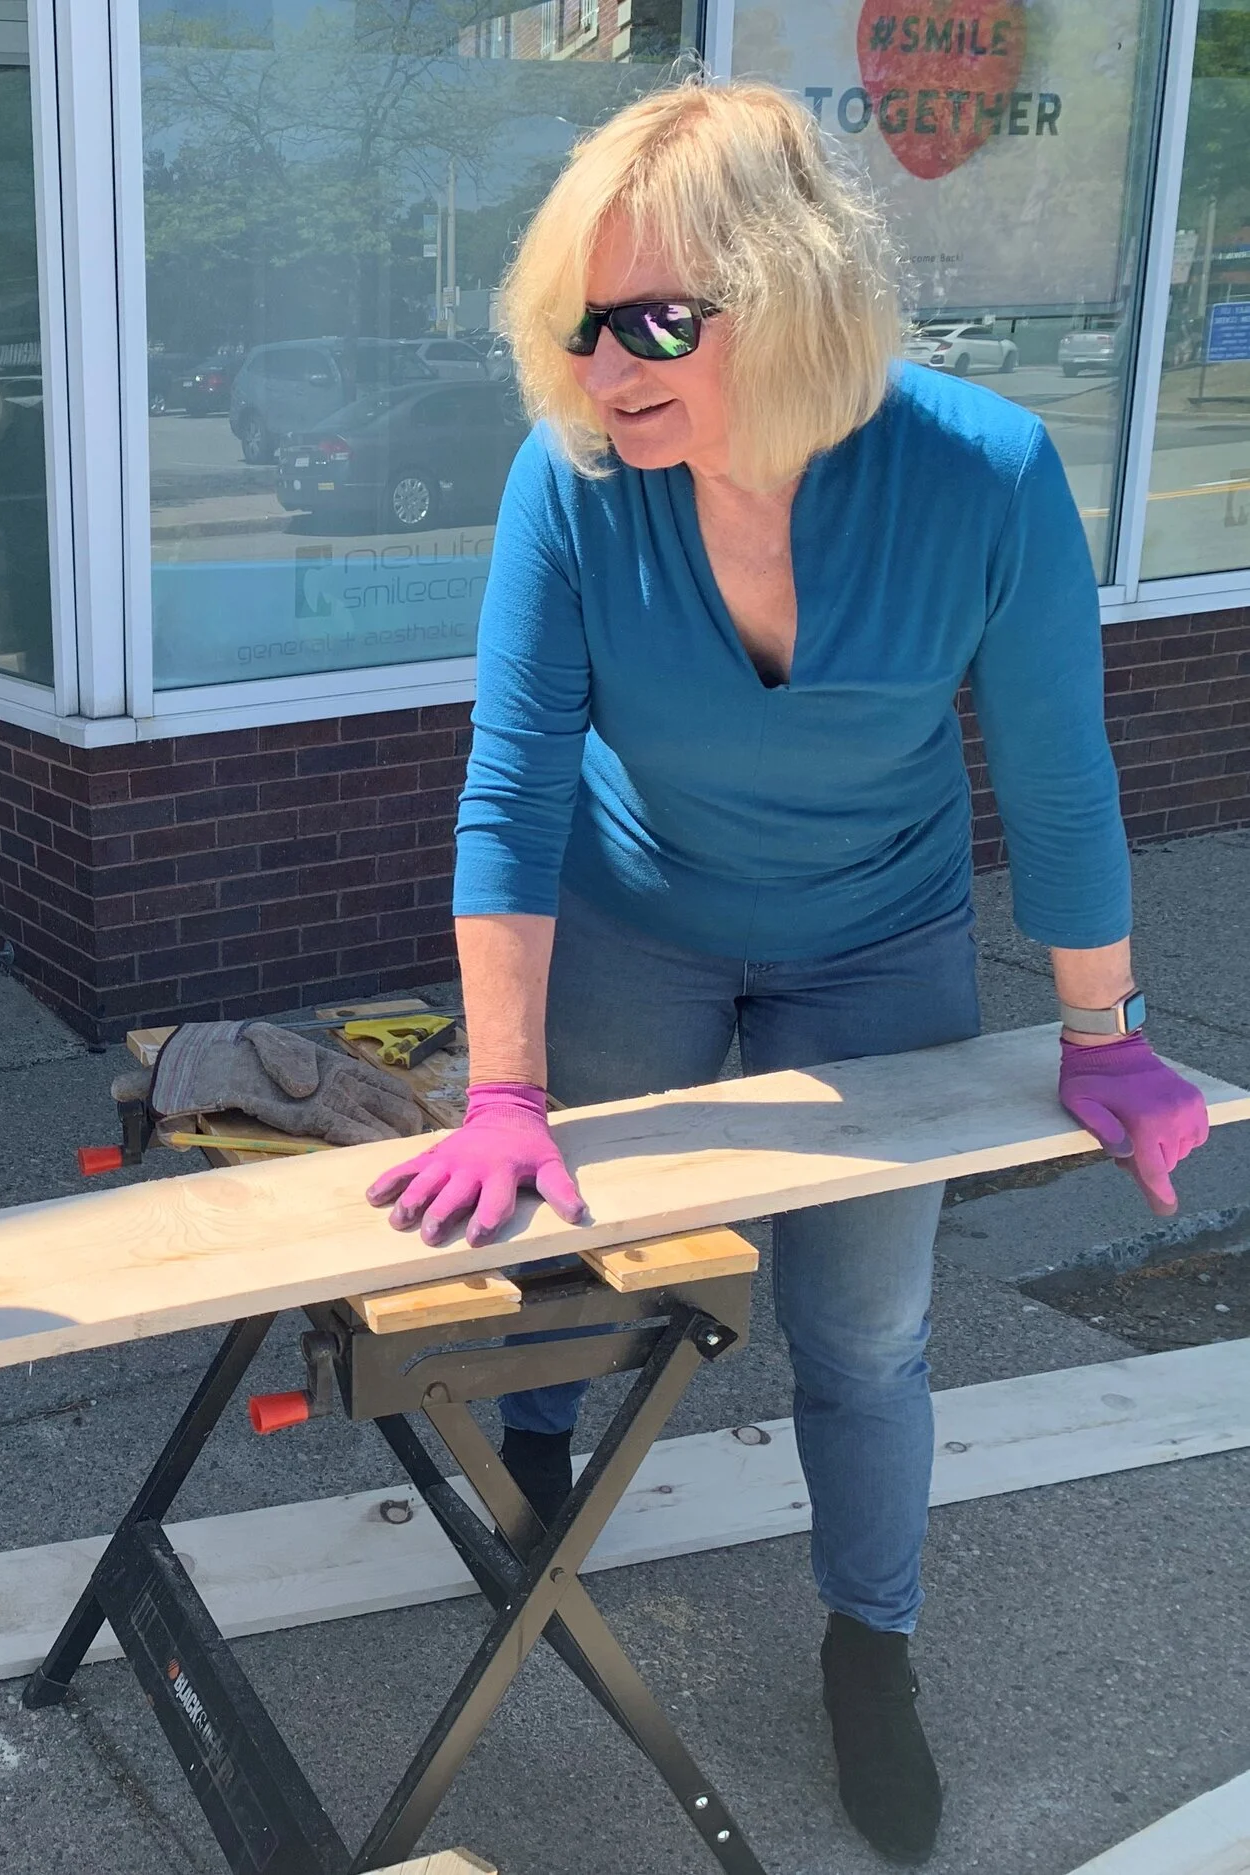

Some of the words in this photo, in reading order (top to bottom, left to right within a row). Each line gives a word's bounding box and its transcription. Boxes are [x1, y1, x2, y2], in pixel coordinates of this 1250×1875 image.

[869, 15, 1012, 55] #SMILE
[805, 86, 1063, 137] TOGETHER
[344, 532, 496, 574] newto
[342, 576, 490, 609] smilecen
[237, 632, 334, 666] general
[364, 620, 467, 647] aesthetic
